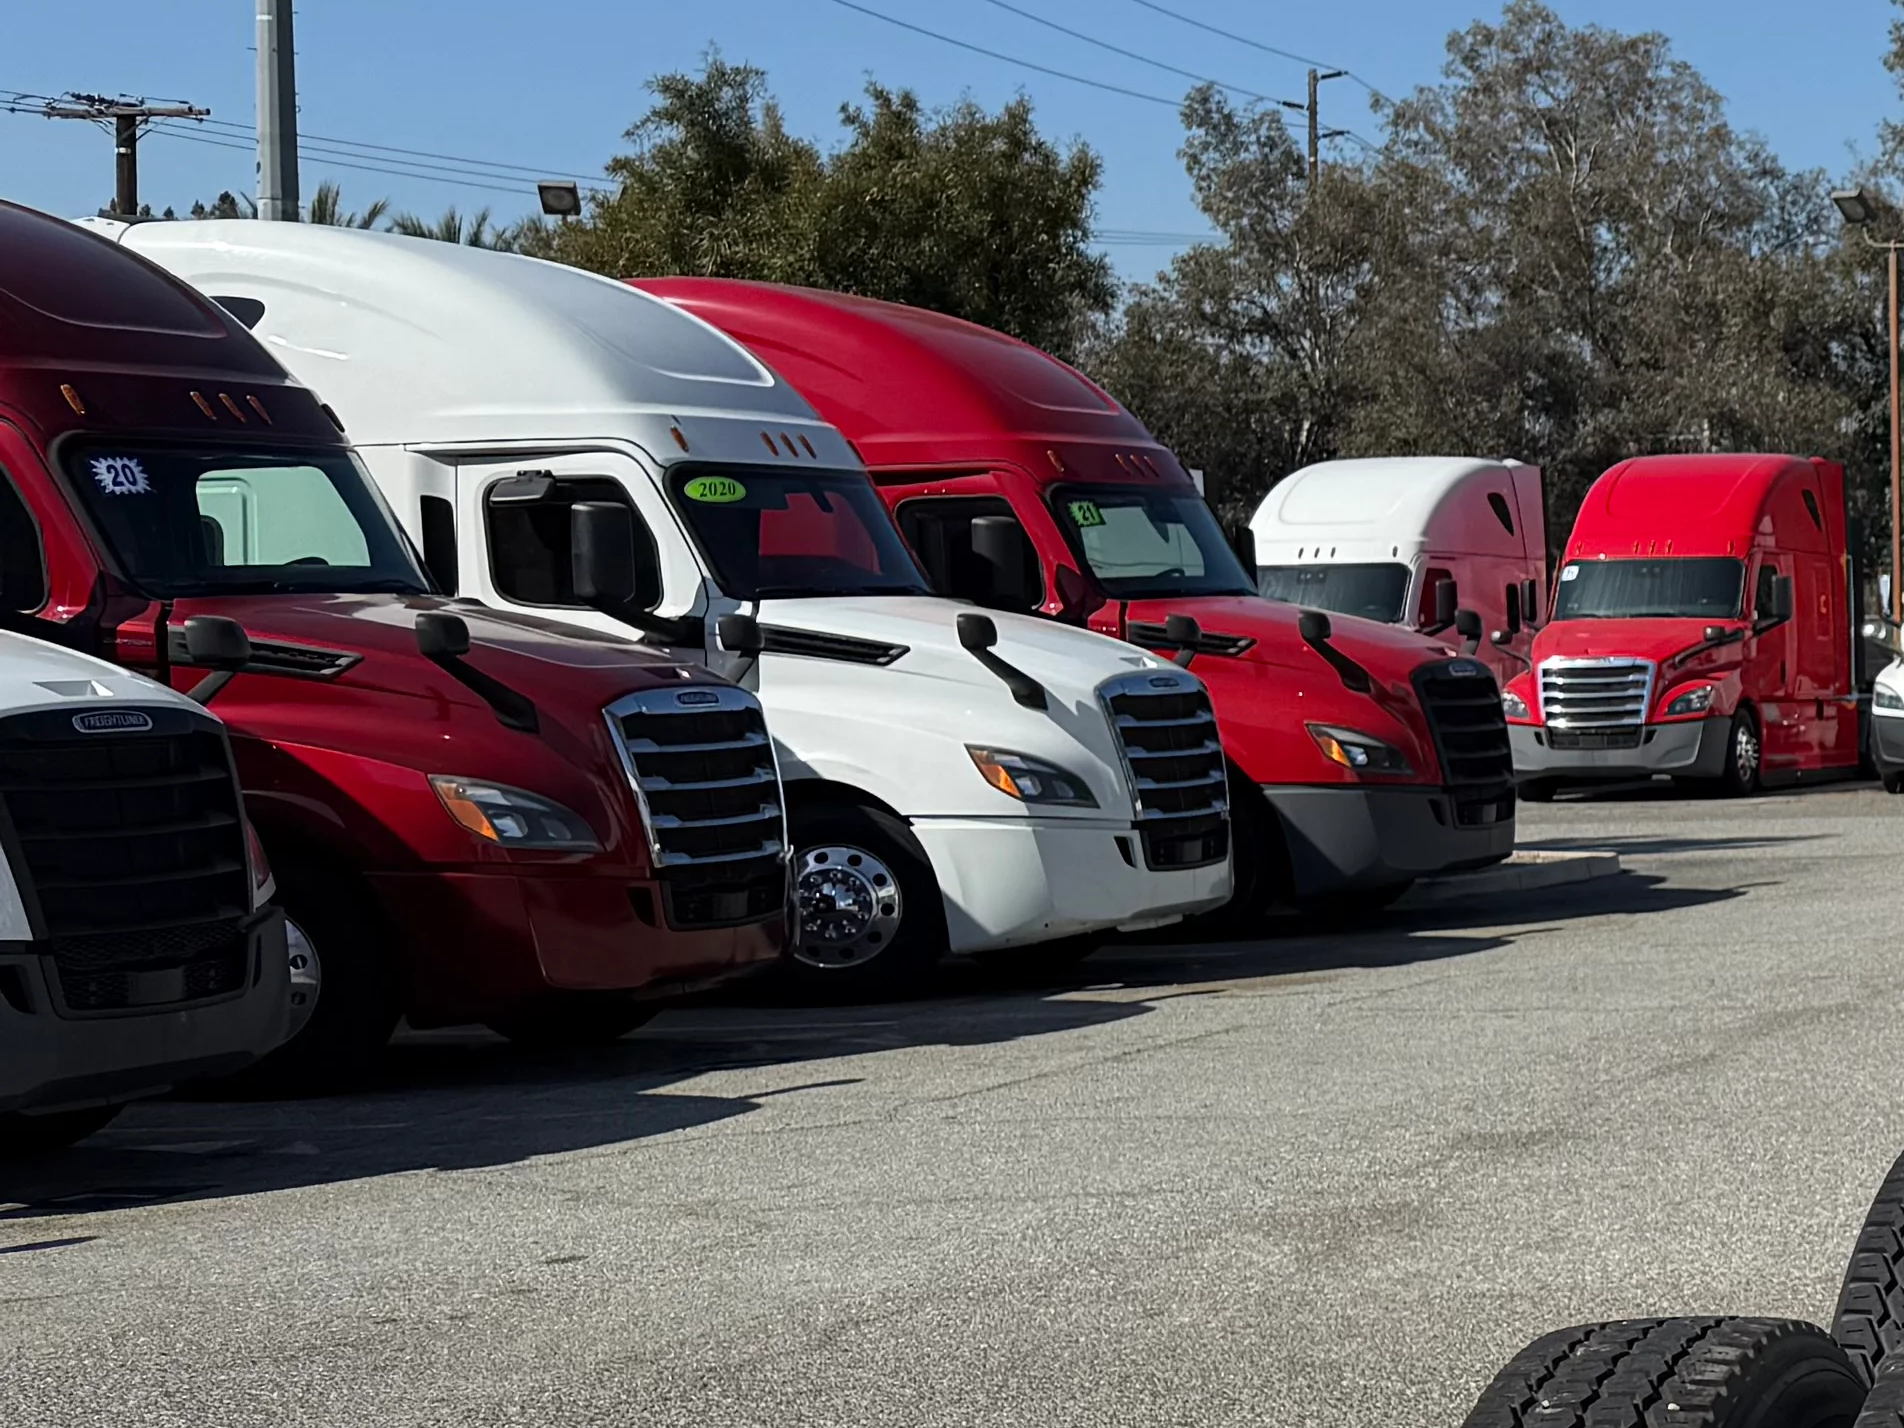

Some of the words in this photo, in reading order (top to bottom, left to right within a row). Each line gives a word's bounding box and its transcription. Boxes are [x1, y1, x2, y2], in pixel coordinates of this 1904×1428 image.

[106, 463, 138, 487] 20
[699, 480, 736, 498] 2020
[1077, 504, 1097, 522] 21
